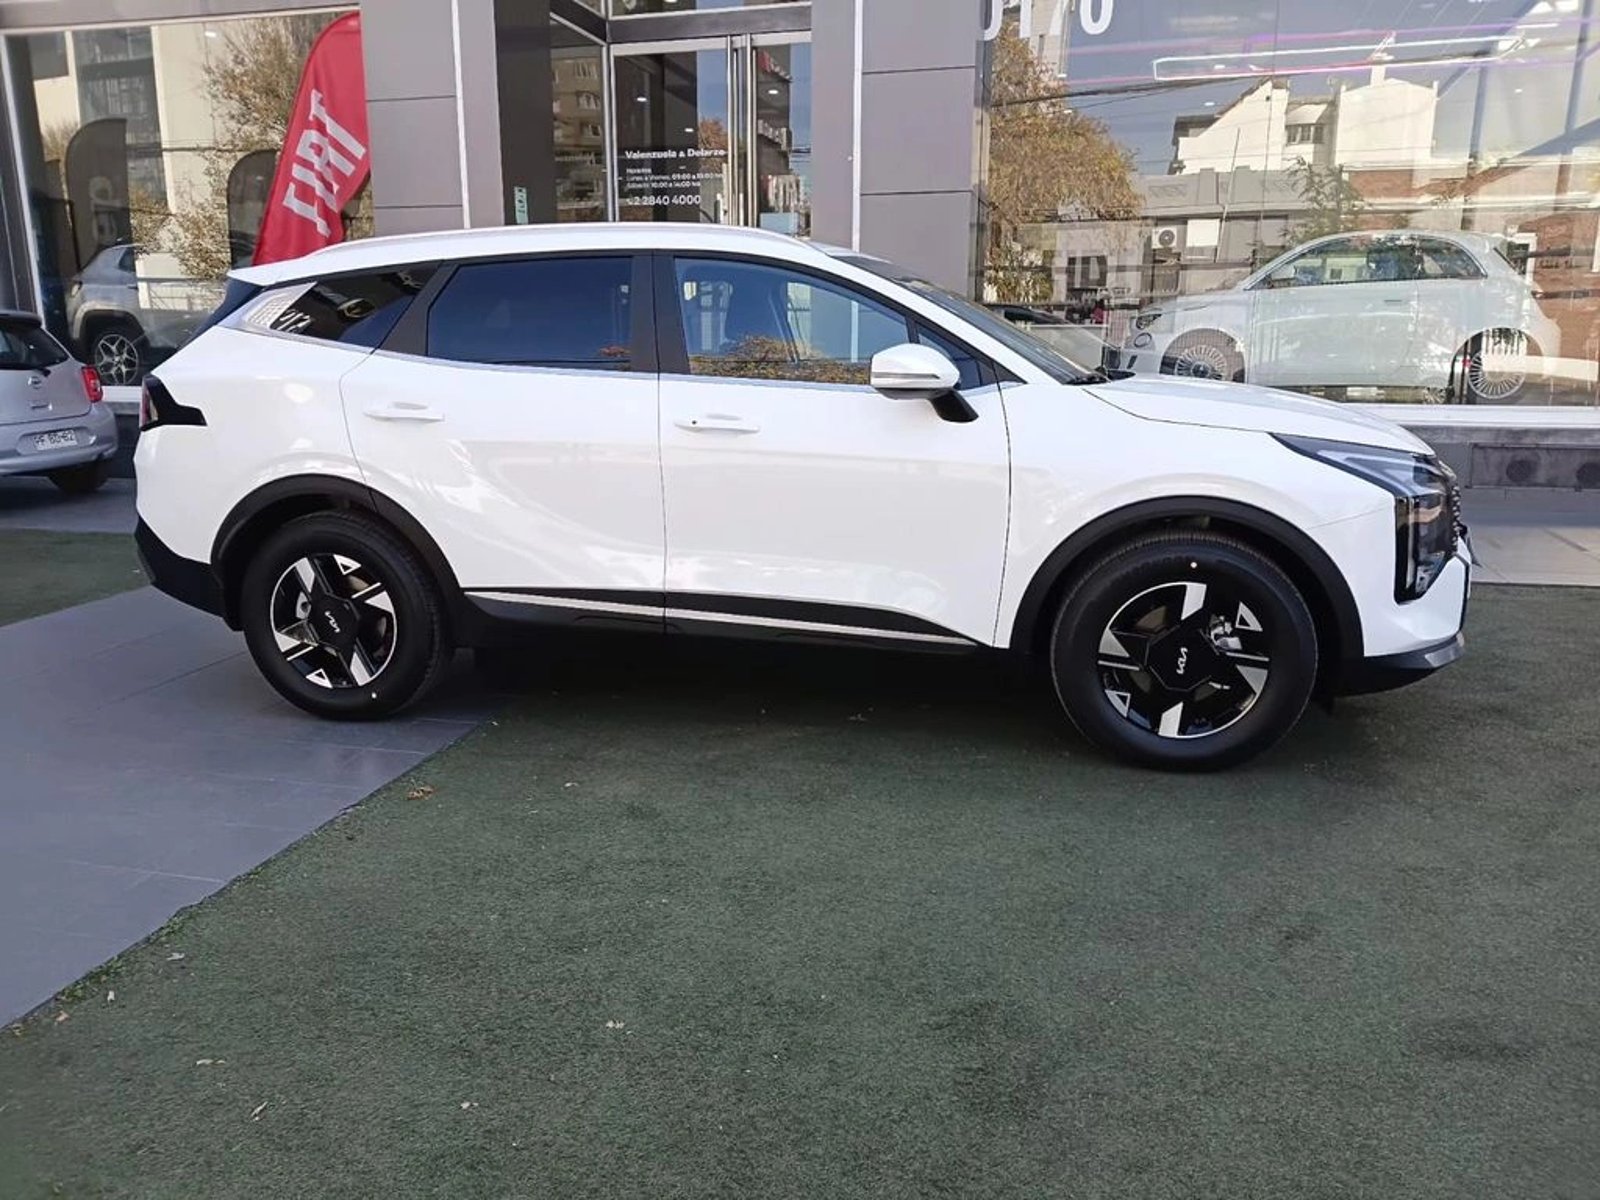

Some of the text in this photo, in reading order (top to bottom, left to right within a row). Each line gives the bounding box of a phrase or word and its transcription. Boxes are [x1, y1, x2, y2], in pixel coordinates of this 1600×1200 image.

[625, 149, 677, 159] Valenzuela
[283, 88, 366, 237] FIAT
[642, 195, 669, 206] 2840
[671, 194, 701, 205] 4000
